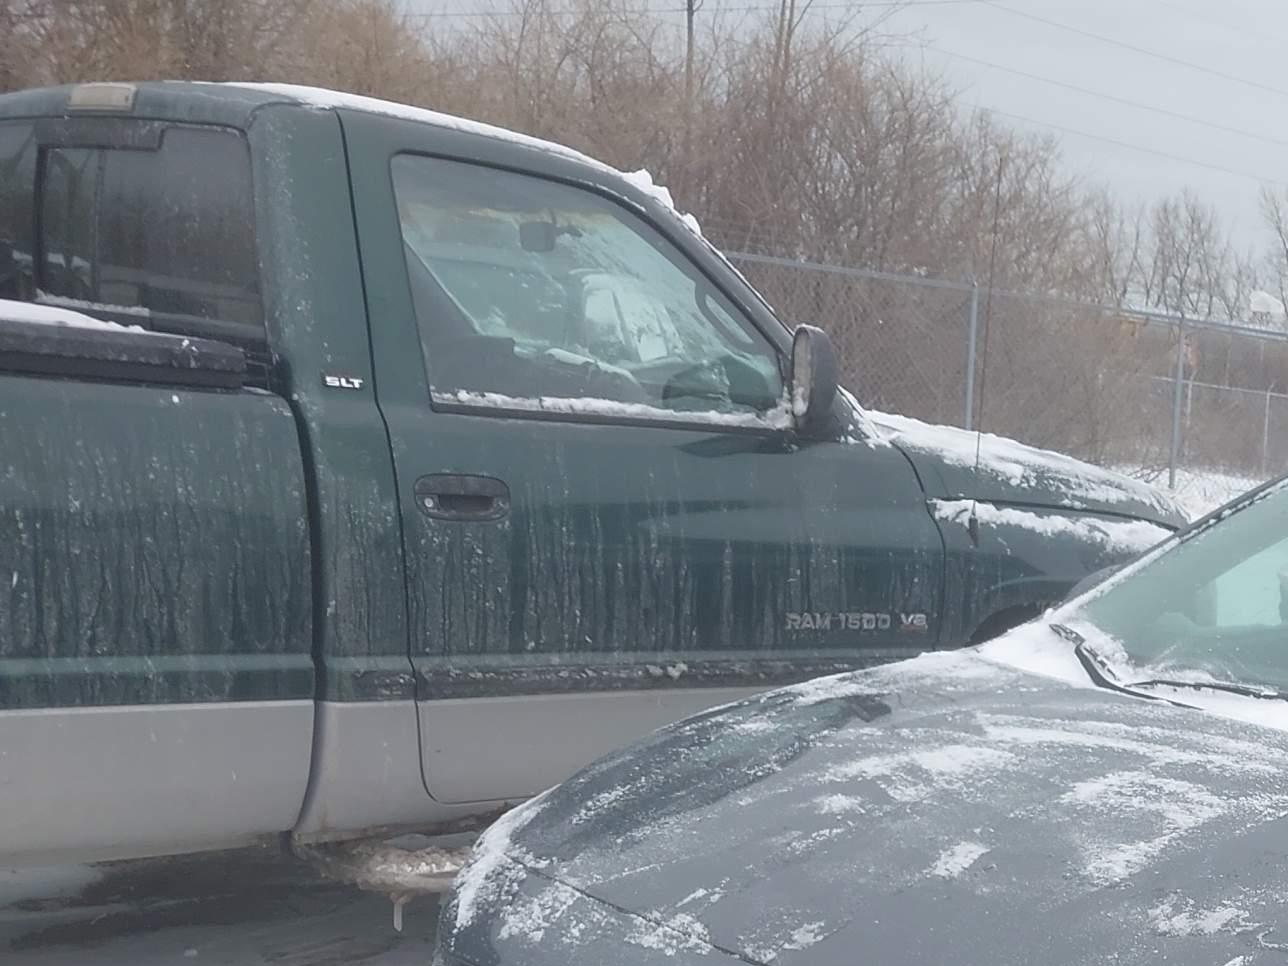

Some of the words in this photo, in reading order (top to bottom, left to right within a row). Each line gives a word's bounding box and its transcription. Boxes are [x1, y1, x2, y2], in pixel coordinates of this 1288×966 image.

[325, 375, 363, 388] SLT
[785, 612, 830, 630] RAM
[839, 612, 891, 630] 1500
